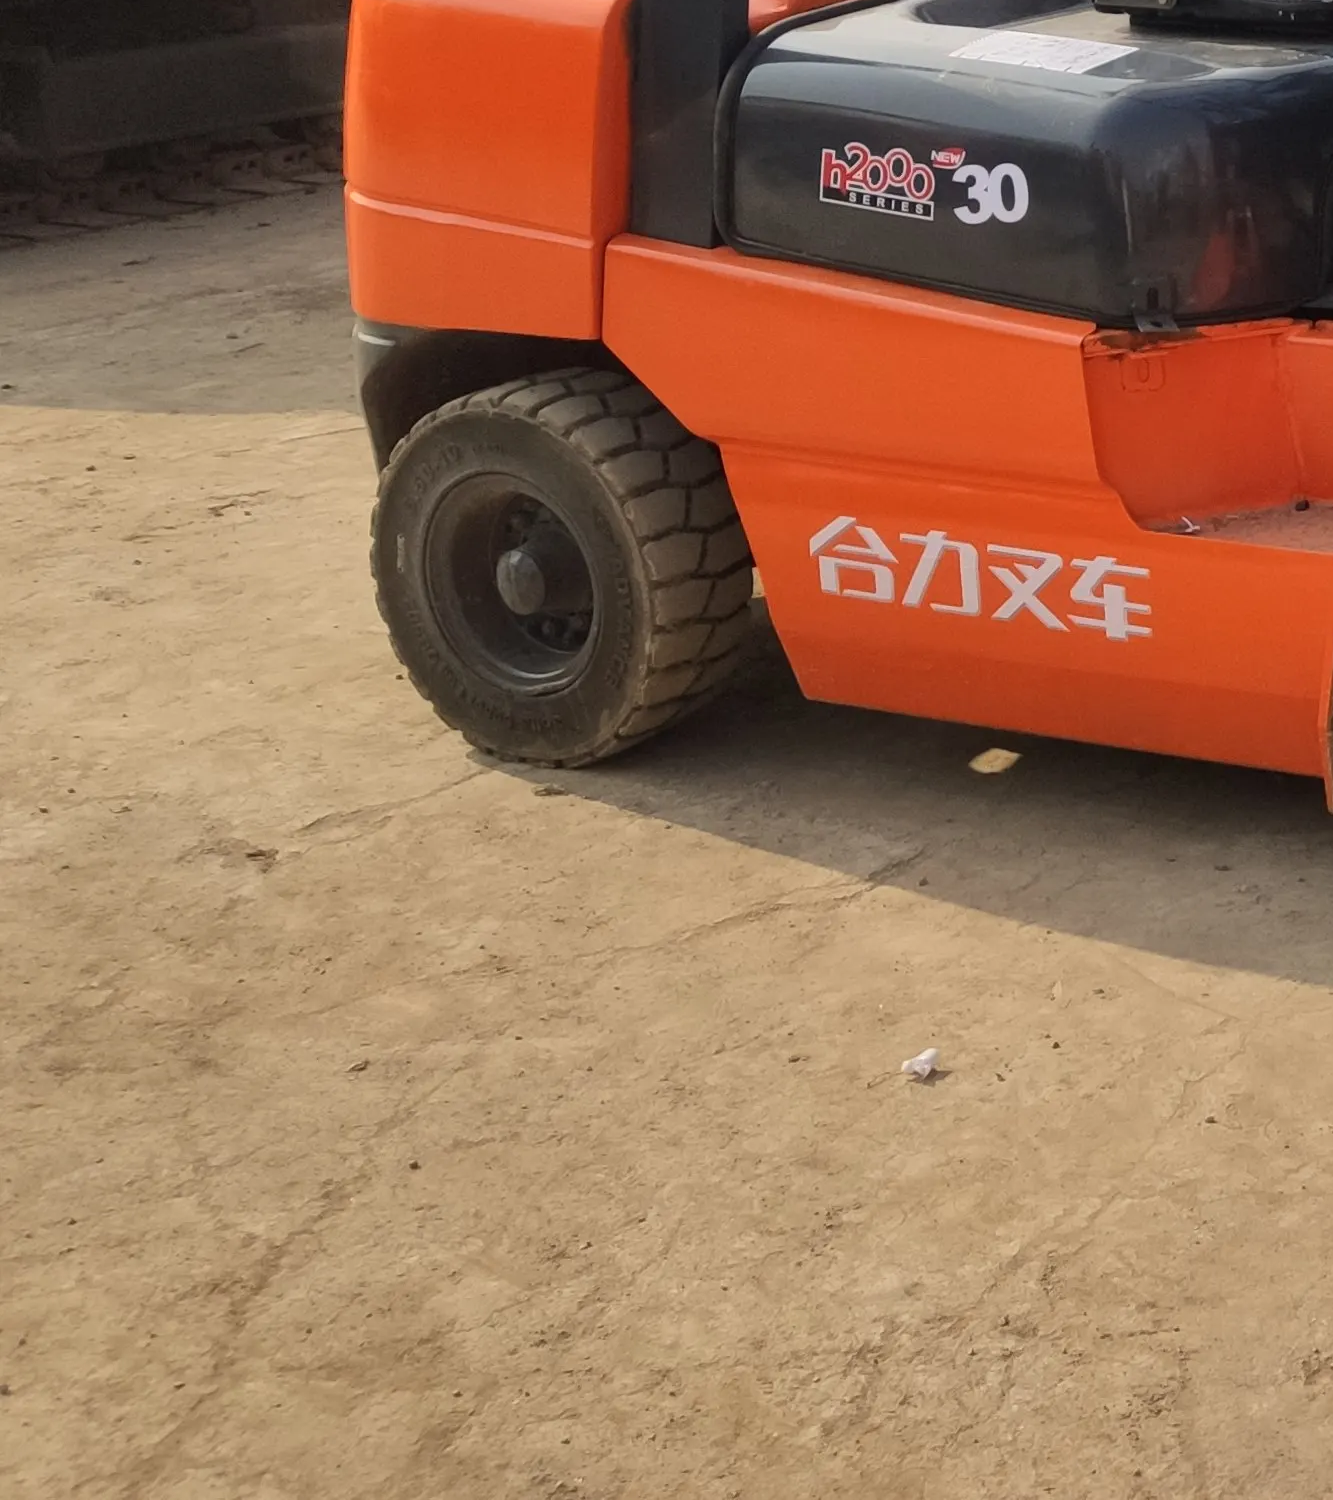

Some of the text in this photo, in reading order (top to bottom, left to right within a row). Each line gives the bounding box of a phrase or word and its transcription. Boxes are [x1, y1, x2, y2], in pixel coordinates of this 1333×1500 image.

[848, 192, 924, 214] SERIES
[930, 150, 962, 164] NEW
[952, 163, 1029, 225] 30
[809, 515, 1152, 641] 合力叉车
